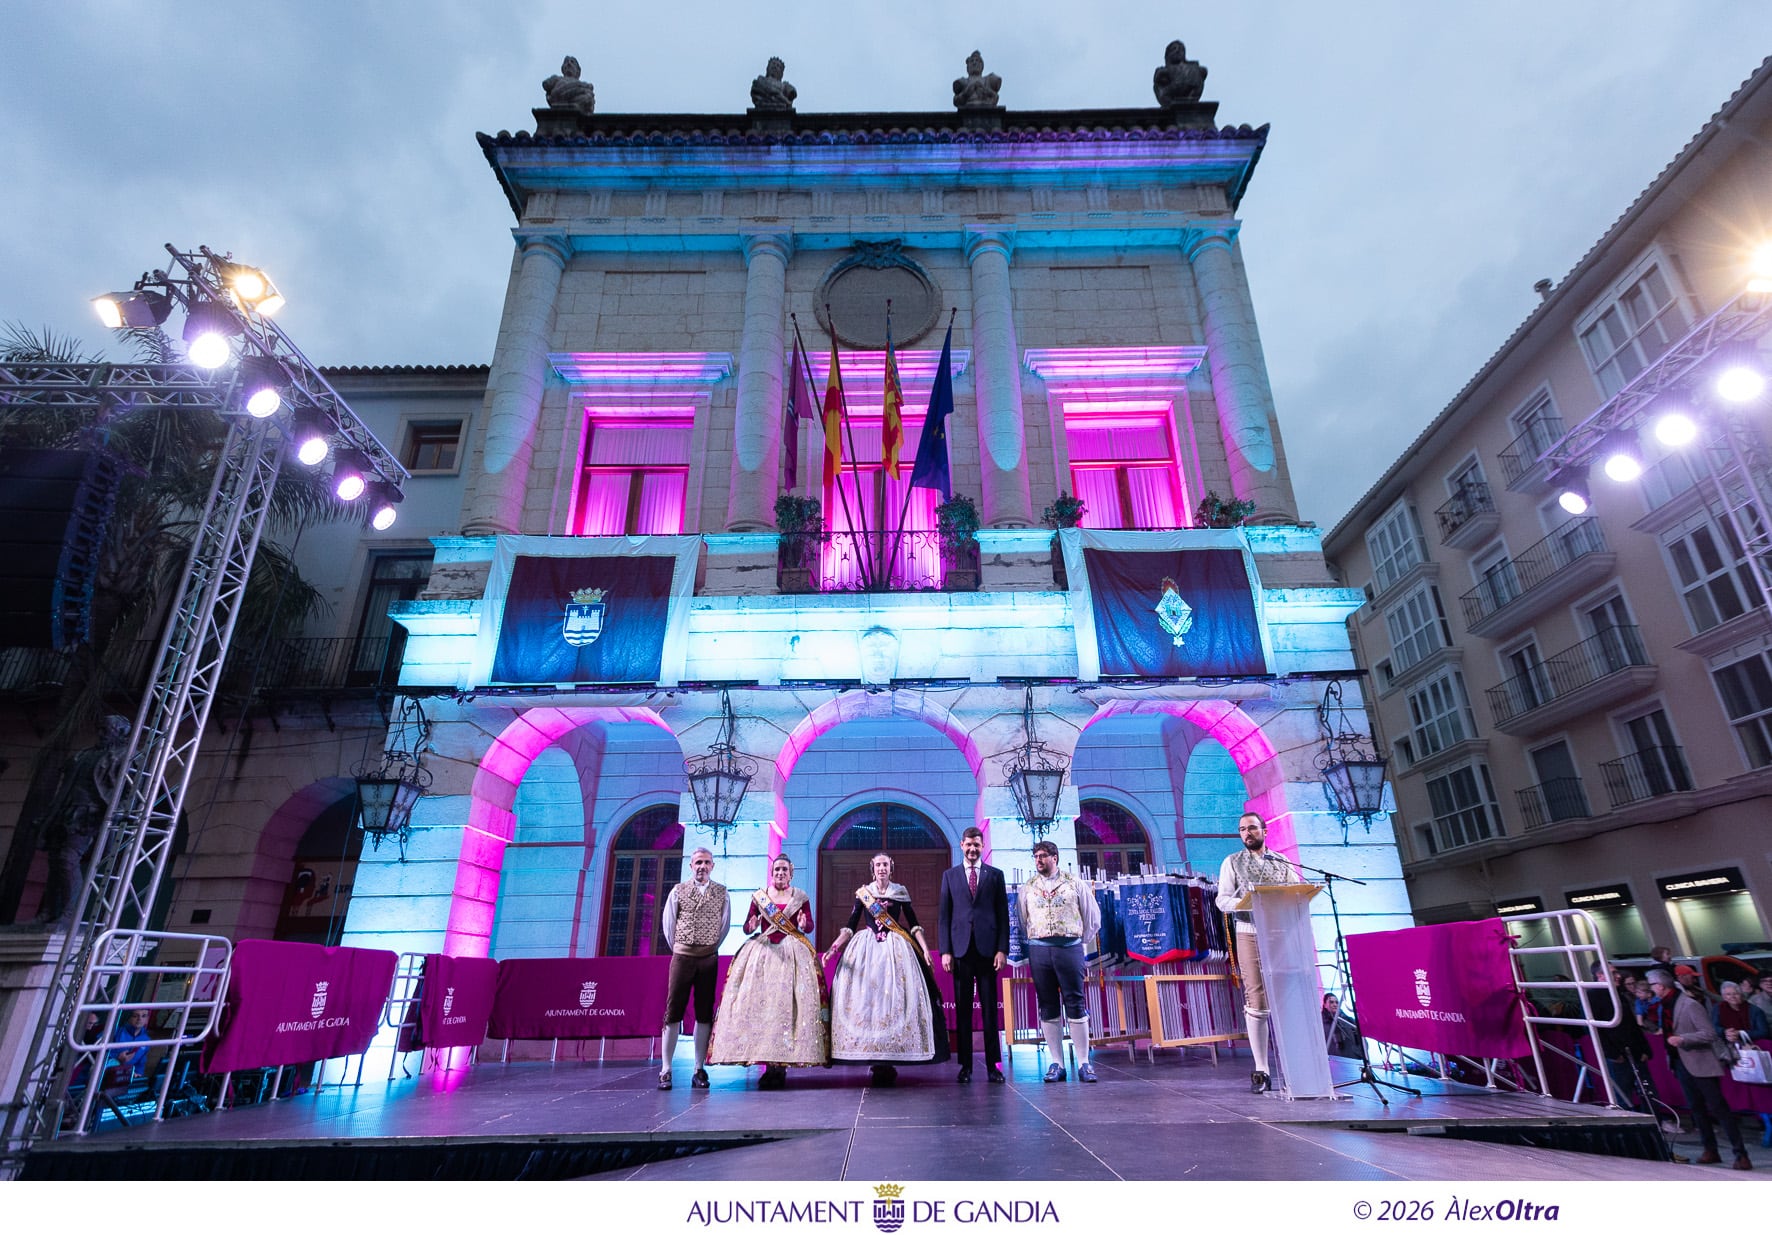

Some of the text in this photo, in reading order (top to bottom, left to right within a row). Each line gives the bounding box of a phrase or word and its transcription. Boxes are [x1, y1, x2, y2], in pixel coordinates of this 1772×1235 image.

[1143, 921, 1152, 932] 7
[545, 1008, 625, 1017] AJUNTAMENT DE GANDIA
[1395, 1008, 1466, 1023] AJUNTAMENT DE GANDIA
[275, 1020, 318, 1033] AJUNTAMENT
